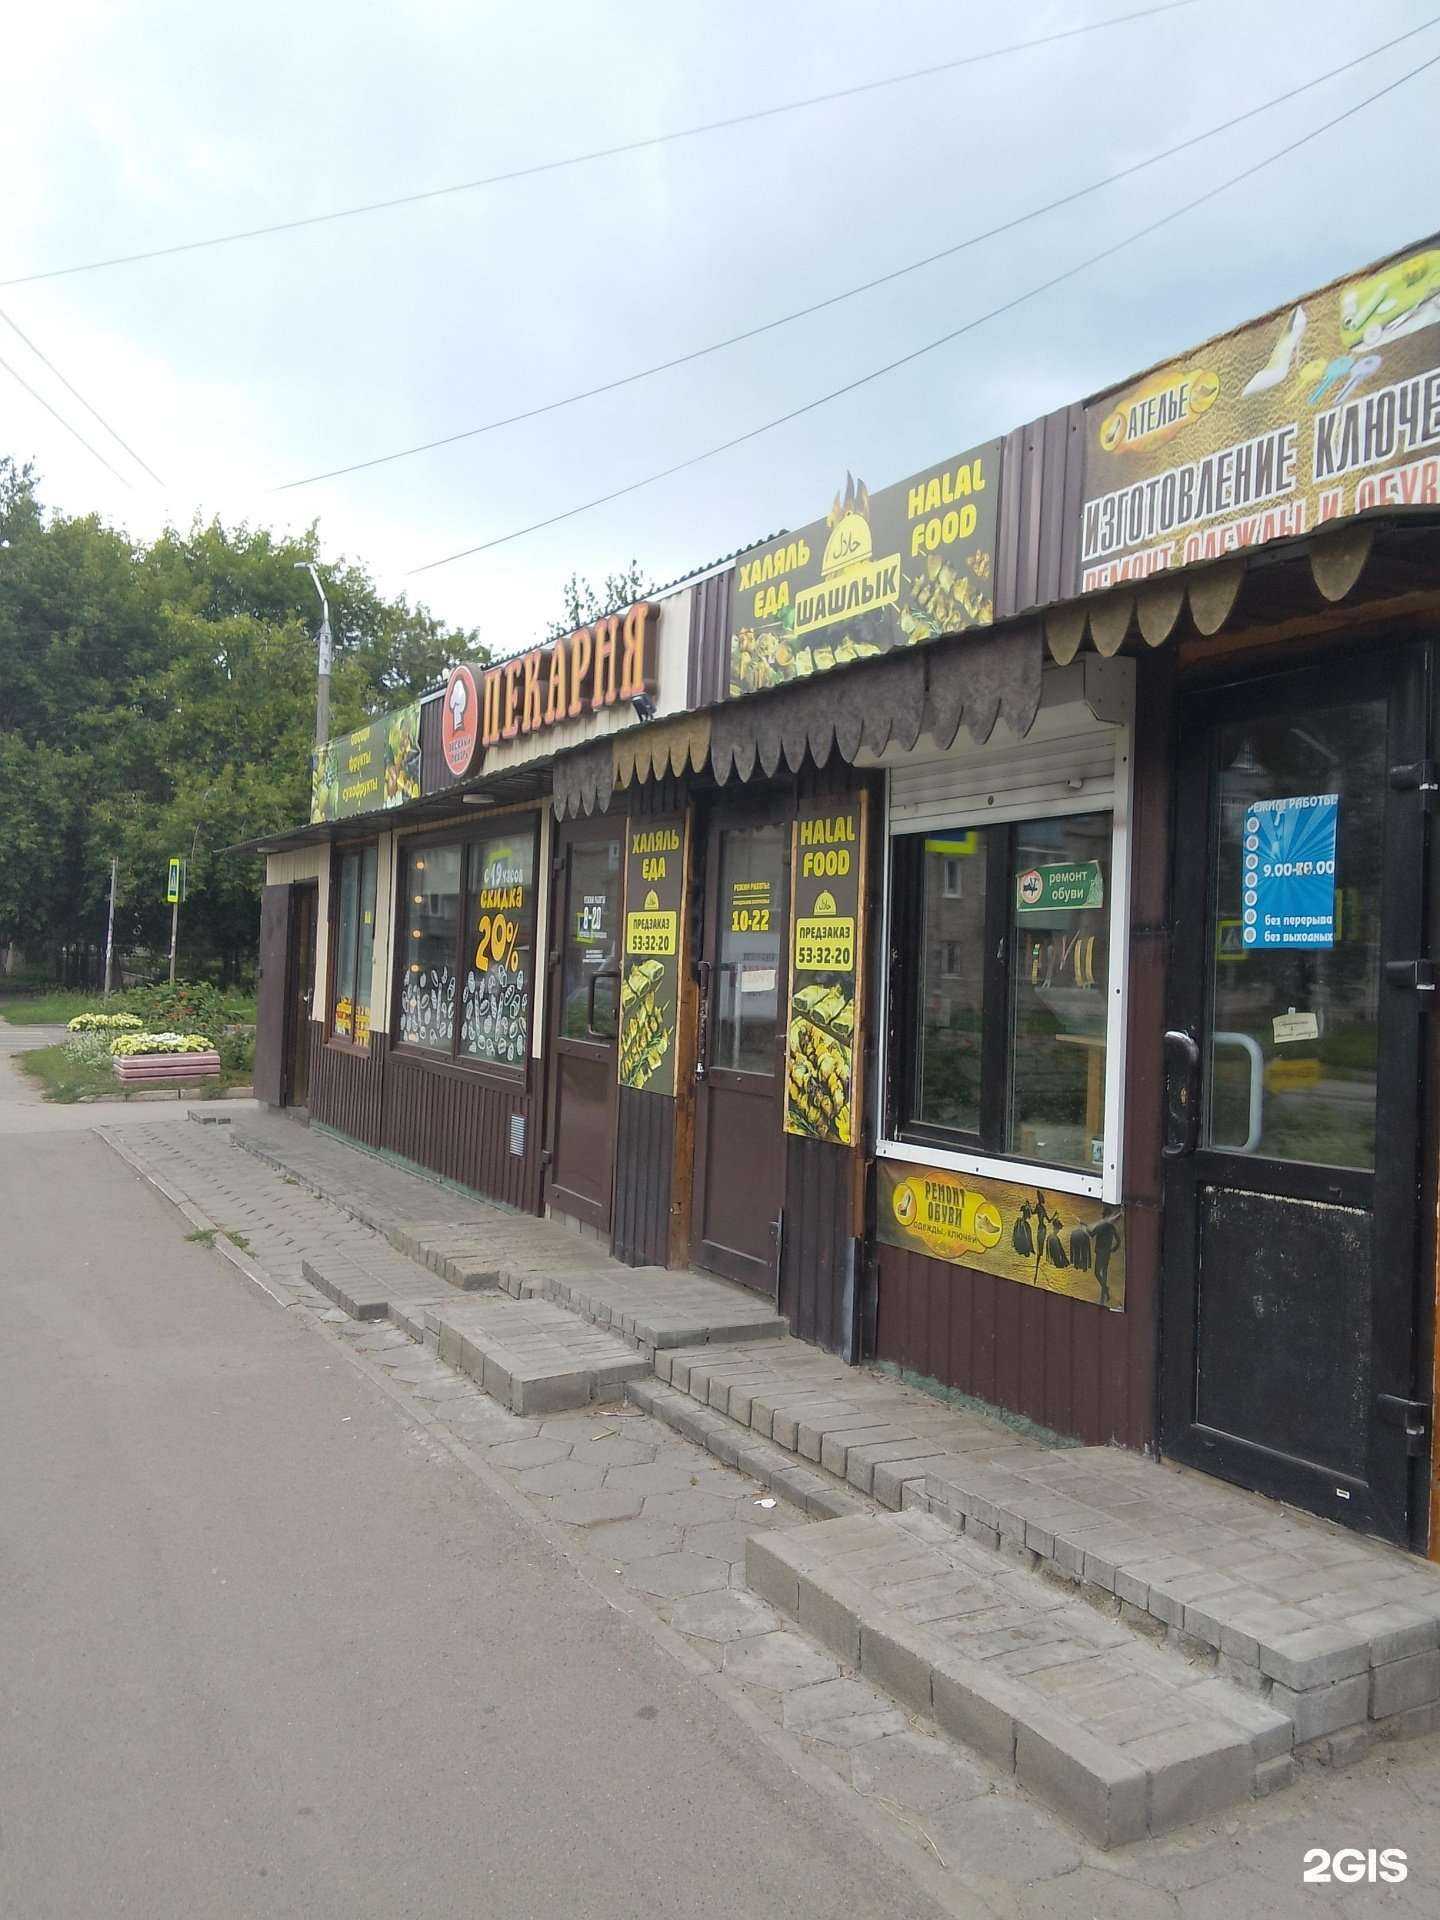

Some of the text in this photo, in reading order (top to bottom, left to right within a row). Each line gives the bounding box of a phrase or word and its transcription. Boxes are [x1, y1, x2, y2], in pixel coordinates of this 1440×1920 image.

[1127, 383, 1189, 440] АТЕЛЬЕ
[908, 459, 986, 519] HALAL
[1082, 425, 1297, 560] ИЗГОТОВЛЕНИЕ
[911, 503, 977, 557] FOOD
[739, 539, 811, 592] ХАЛЯЛЬ
[754, 580, 789, 618] ЕДА
[796, 564, 898, 628] ШАШЛЫК
[482, 601, 650, 747] ПЕКАРНЯ
[632, 829, 680, 854] ХАЛЯЛЬ
[800, 816, 855, 846] HALAL
[642, 857, 666, 881] ЕДА
[803, 849, 850, 878] FOOD
[1049, 871, 1088, 887] ремонт
[1051, 886, 1084, 903] обуви
[633, 918, 670, 932] ПРЕДЗАКАЗ
[731, 909, 770, 932] 10-22
[799, 925, 850, 941] ПРЕДЗАКАЗ
[1264, 914, 1333, 928] без перерыва
[475, 913, 519, 972] 20%
[1264, 931, 1334, 943] без выходных
[924, 1181, 966, 1209] РЕМОНТ
[927, 1201, 962, 1228] ОБУВИ
